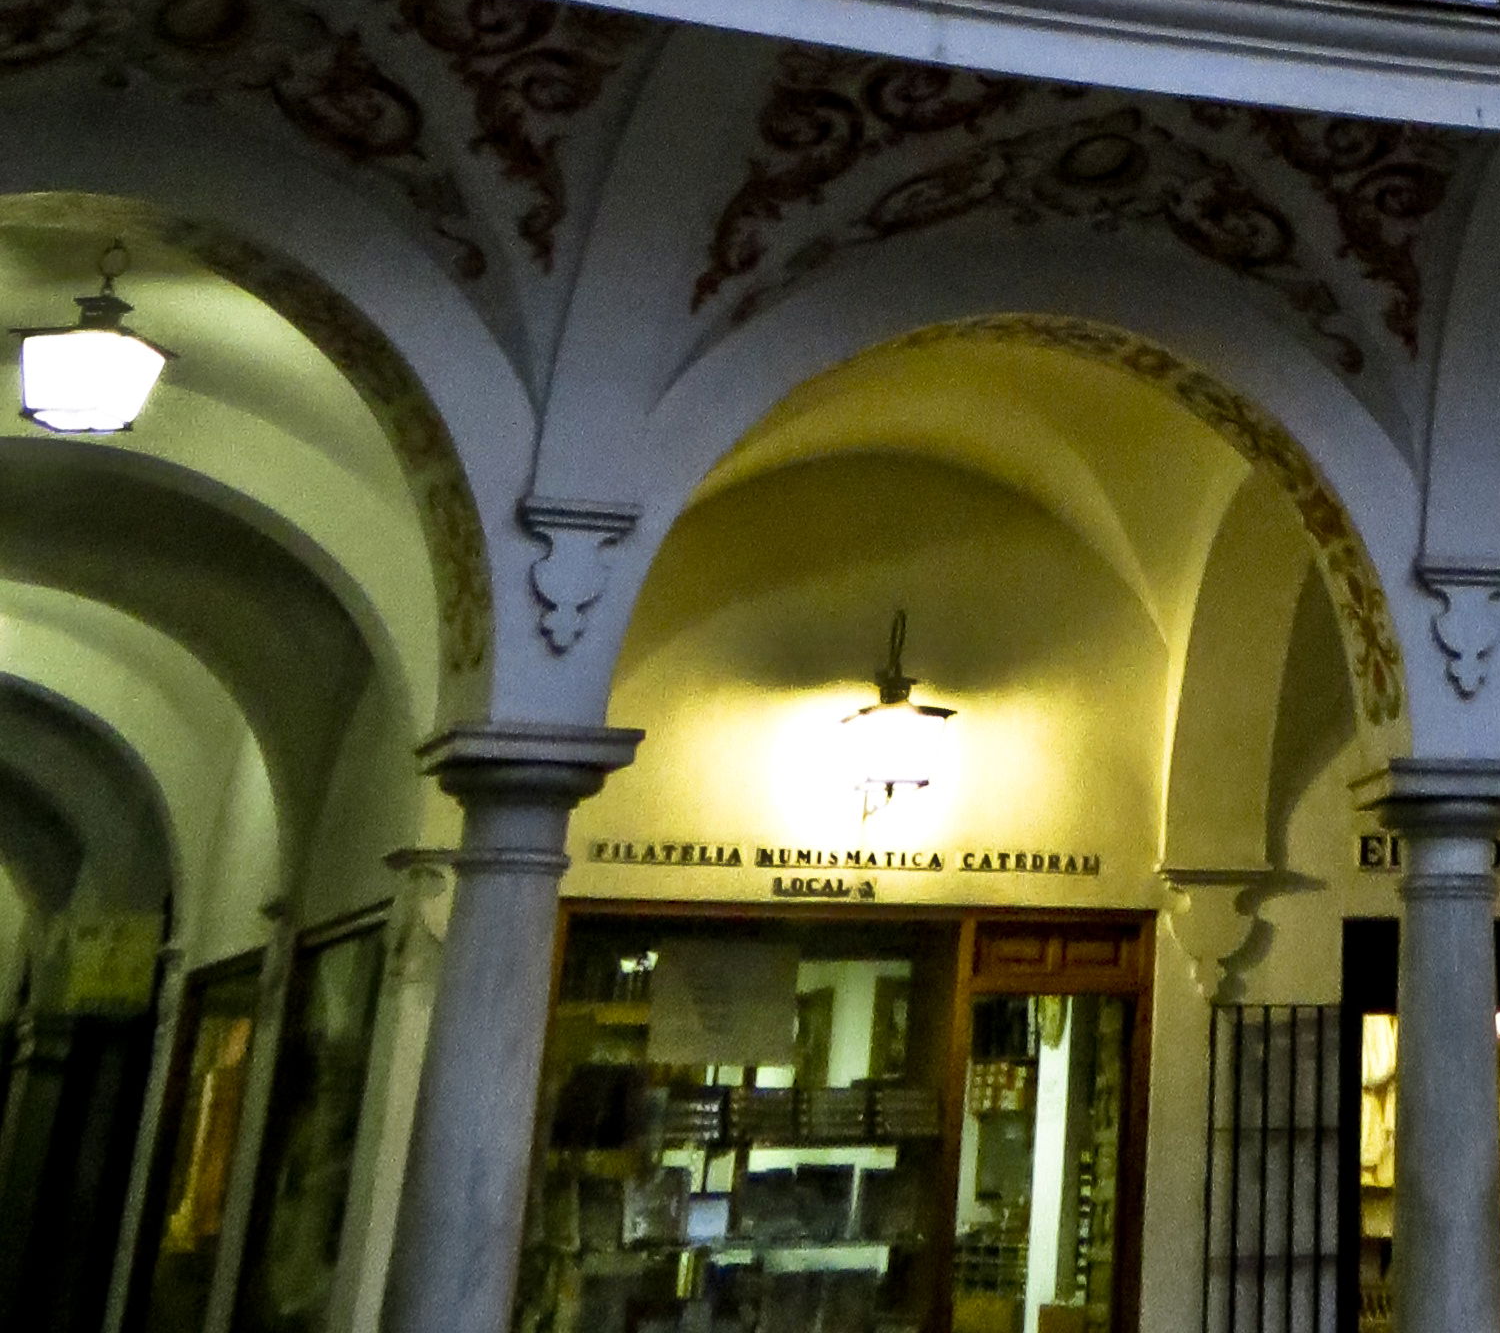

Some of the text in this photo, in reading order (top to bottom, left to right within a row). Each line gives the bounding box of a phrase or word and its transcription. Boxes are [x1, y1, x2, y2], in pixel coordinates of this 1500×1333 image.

[592, 842, 1100, 874] FILATELIA NUMISMATICA CATEDRAL
[773, 877, 850, 897] LOCAL
